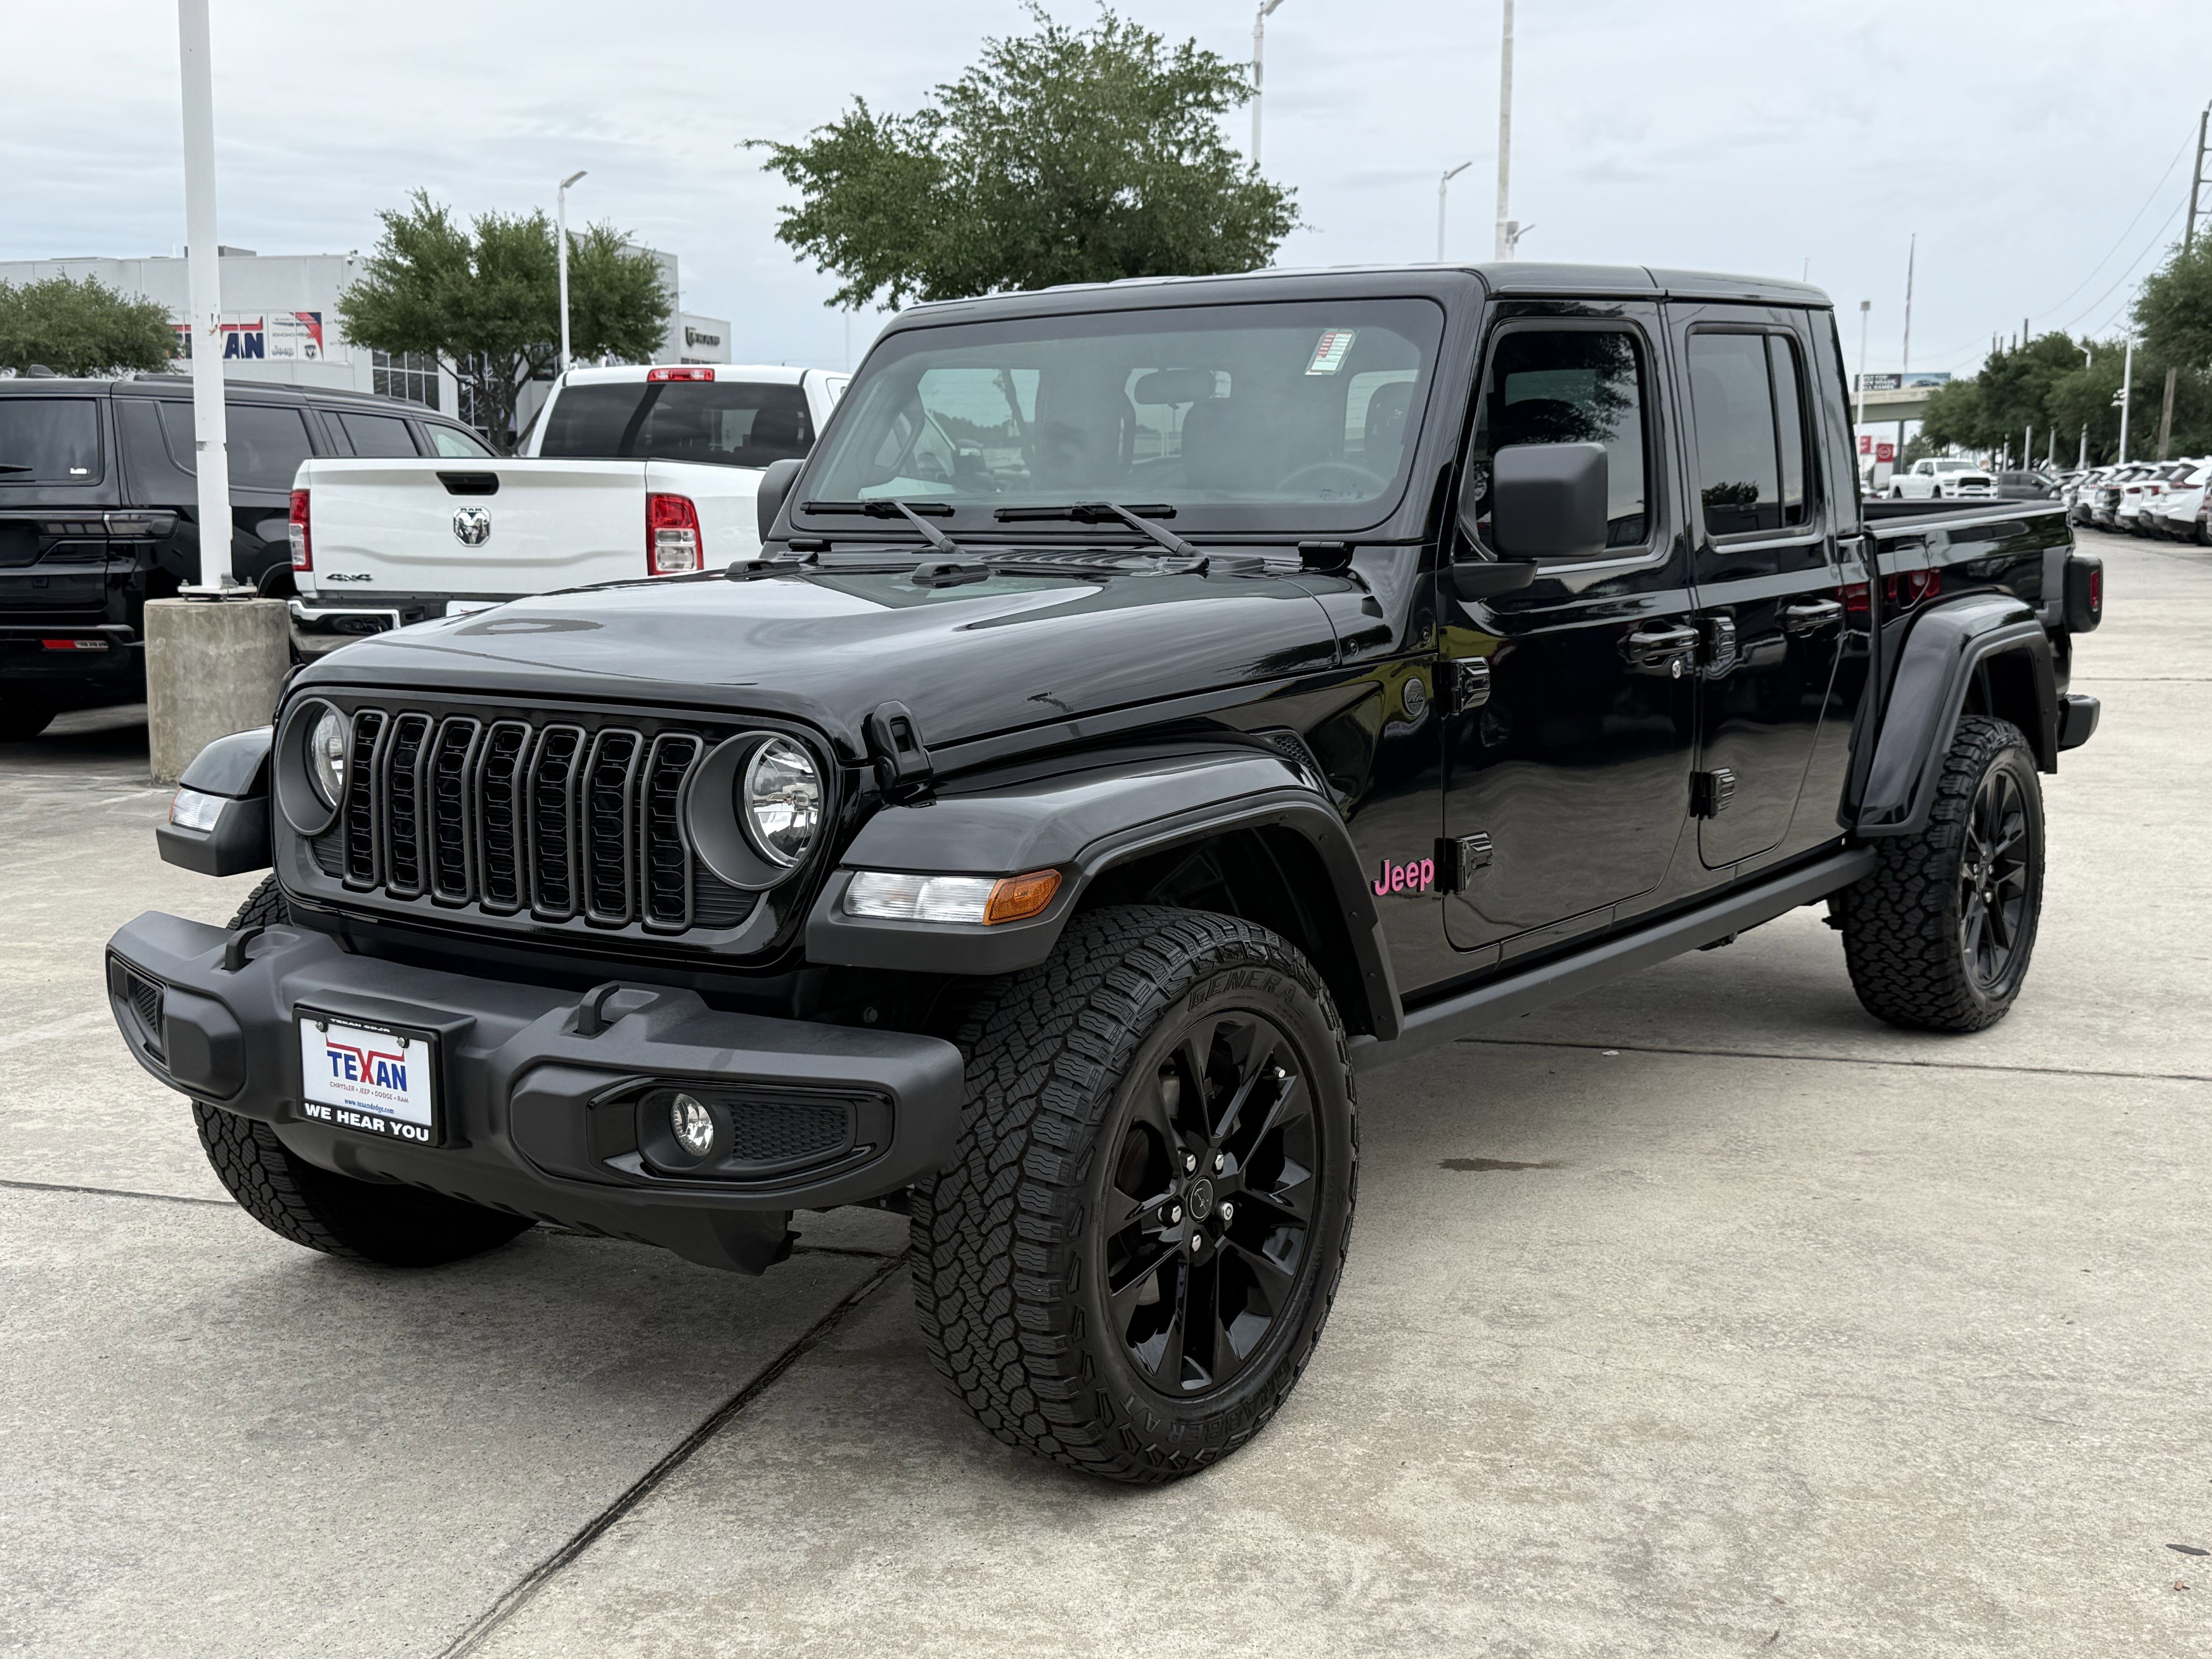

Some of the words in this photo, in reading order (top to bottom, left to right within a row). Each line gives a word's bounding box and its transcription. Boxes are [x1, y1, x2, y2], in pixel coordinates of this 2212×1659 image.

[1373, 858, 1434, 895] Jeep
[330, 1018, 361, 1027] TEXAN
[326, 1046, 407, 1092] TEXAN
[330, 1081, 354, 1091] CHRYSLER
[375, 1091, 393, 1100] DODGE
[305, 1103, 331, 1120] WE
[337, 1110, 385, 1132] HEAR
[390, 1121, 429, 1141] YOU
